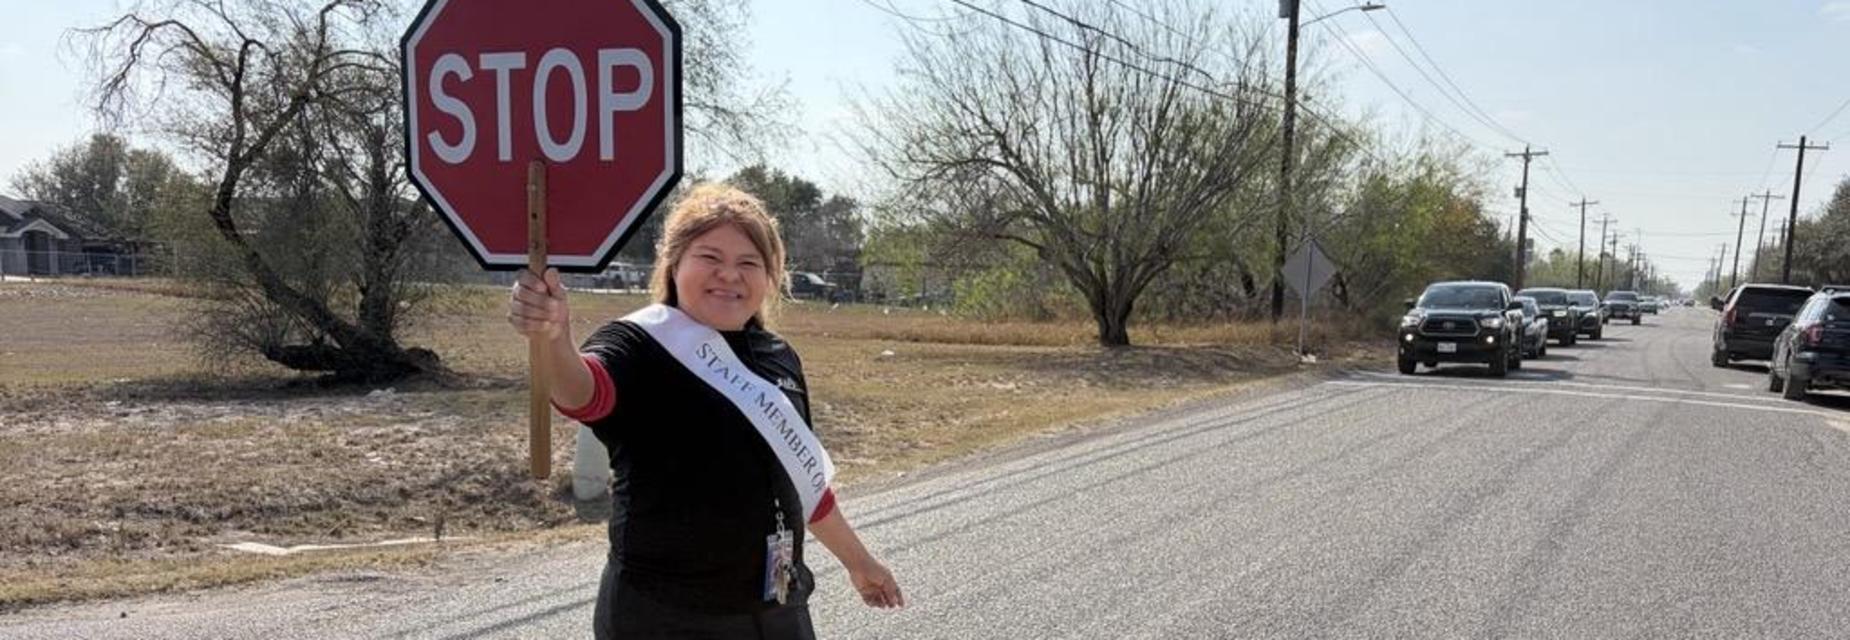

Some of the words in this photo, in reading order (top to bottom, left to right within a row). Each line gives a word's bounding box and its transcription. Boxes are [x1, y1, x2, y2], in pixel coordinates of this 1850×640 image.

[428, 48, 653, 163] STOP
[696, 342, 753, 391] STAFF
[754, 392, 818, 475] MEMBER
